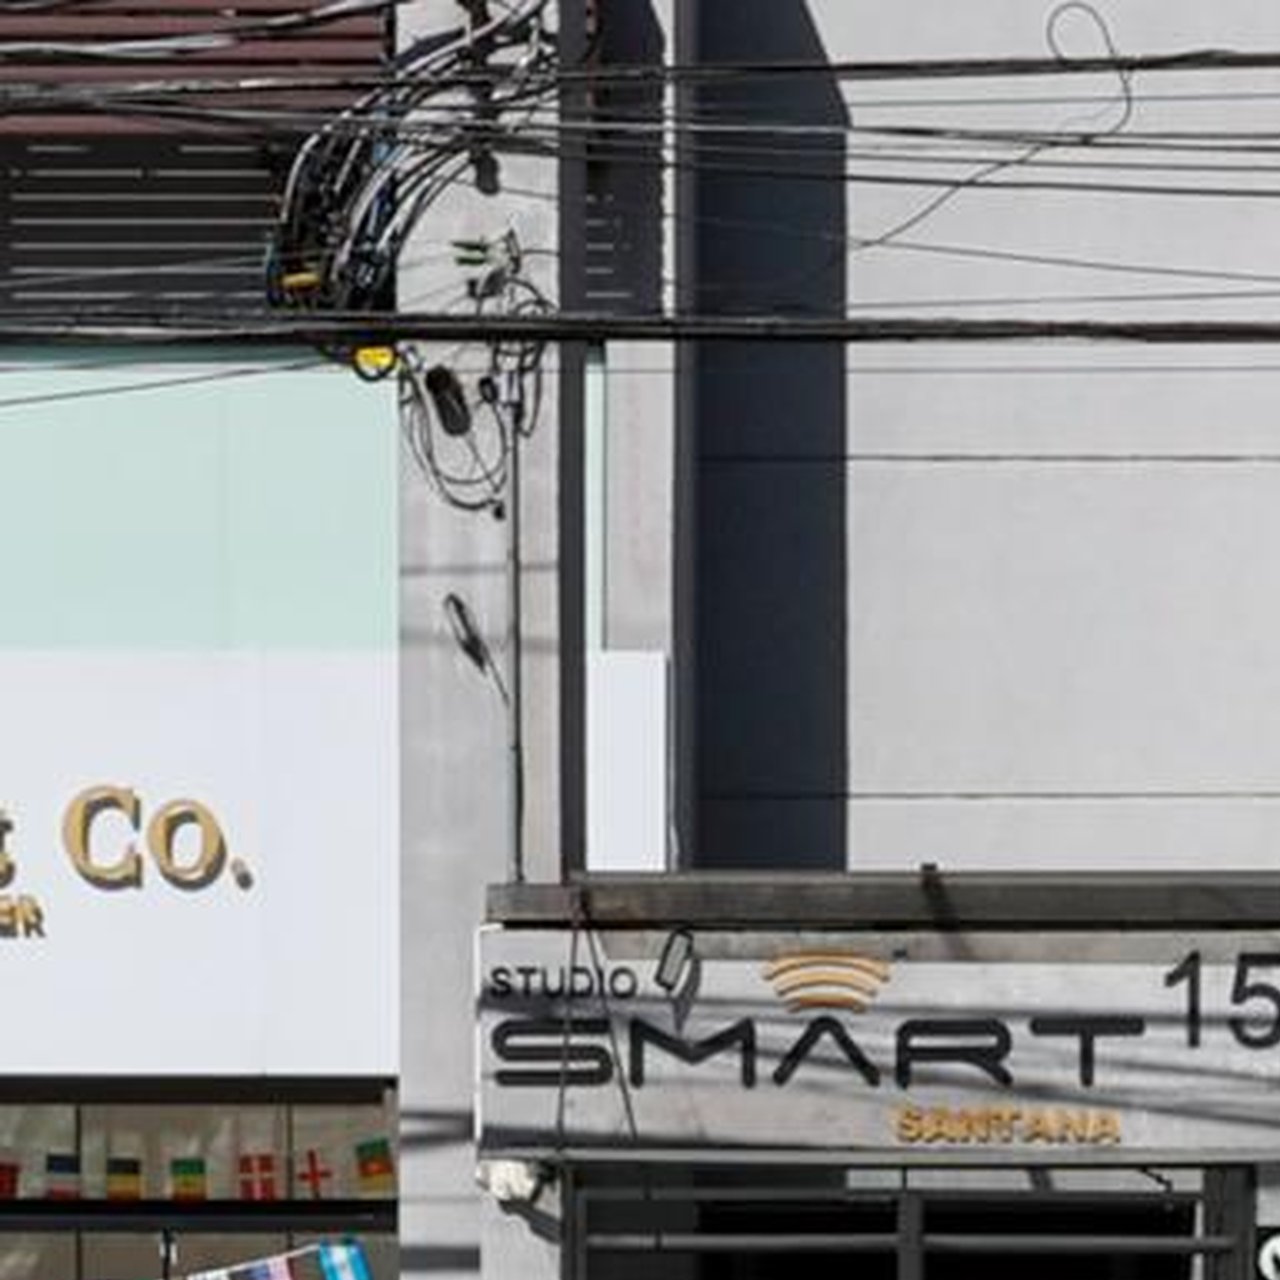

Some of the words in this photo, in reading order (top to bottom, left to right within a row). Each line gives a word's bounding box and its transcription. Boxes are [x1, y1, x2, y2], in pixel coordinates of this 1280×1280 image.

[62, 783, 254, 892] Co.
[491, 967, 638, 999] STUDIO
[492, 1015, 1147, 1089] SMART
[898, 1107, 1121, 1144] SANTANA
